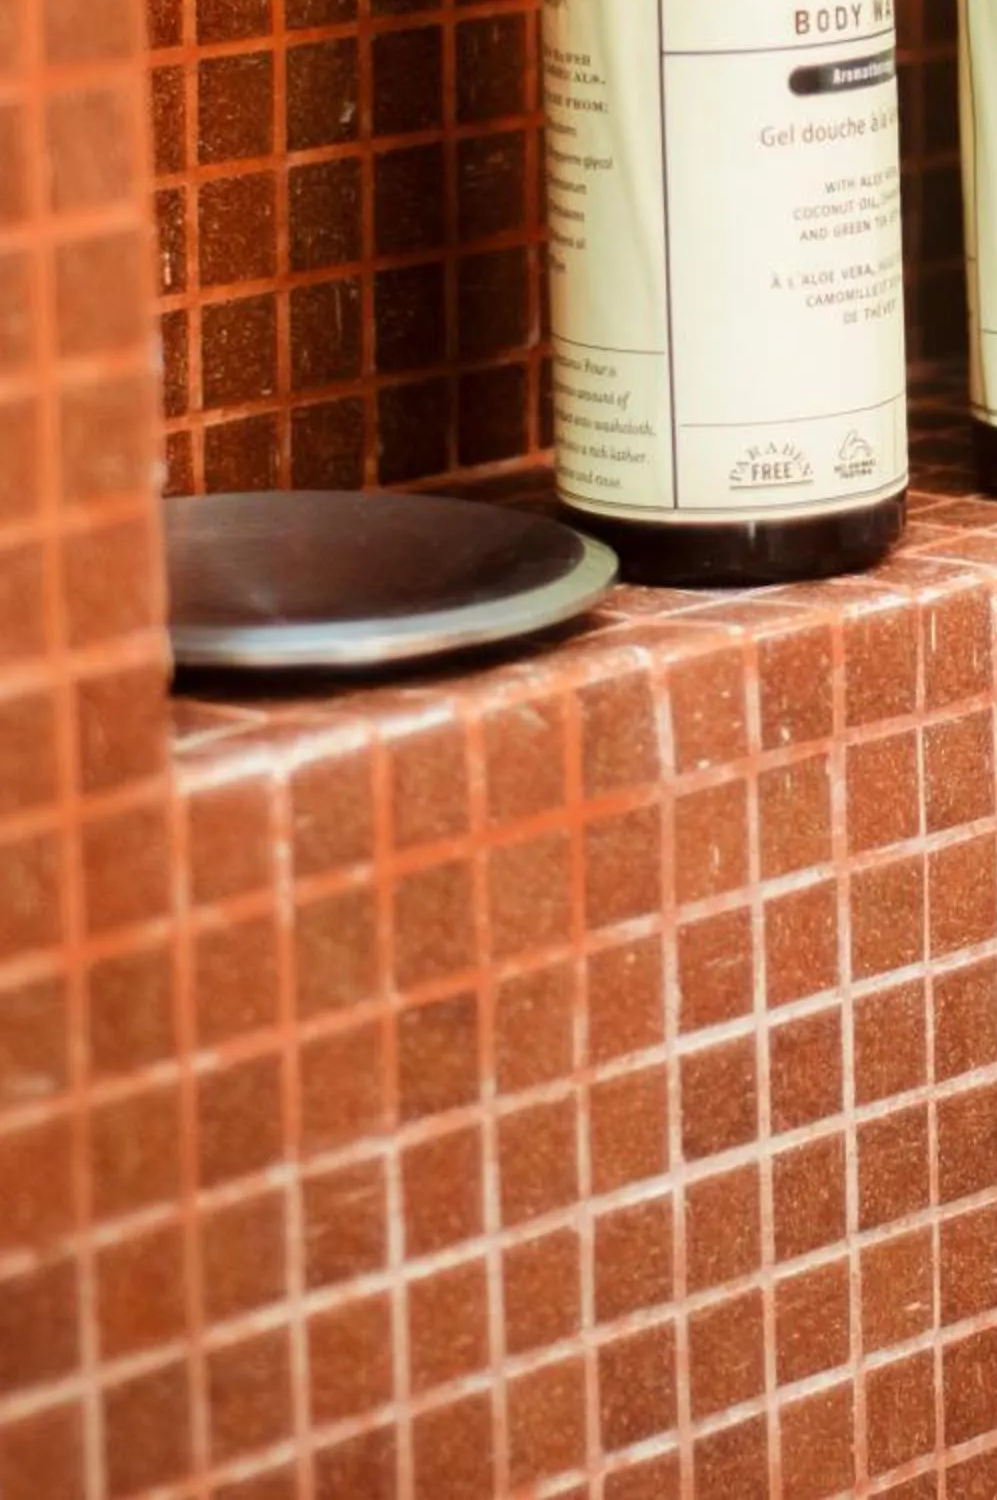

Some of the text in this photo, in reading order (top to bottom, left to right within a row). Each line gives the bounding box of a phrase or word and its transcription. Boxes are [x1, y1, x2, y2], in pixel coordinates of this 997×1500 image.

[795, 3, 862, 35] BODY
[760, 120, 795, 149] Gel
[801, 114, 866, 144] douche
[824, 178, 855, 194] WITH
[793, 200, 854, 221] COCONUT
[799, 227, 828, 242] AND
[752, 461, 793, 481] FREE
